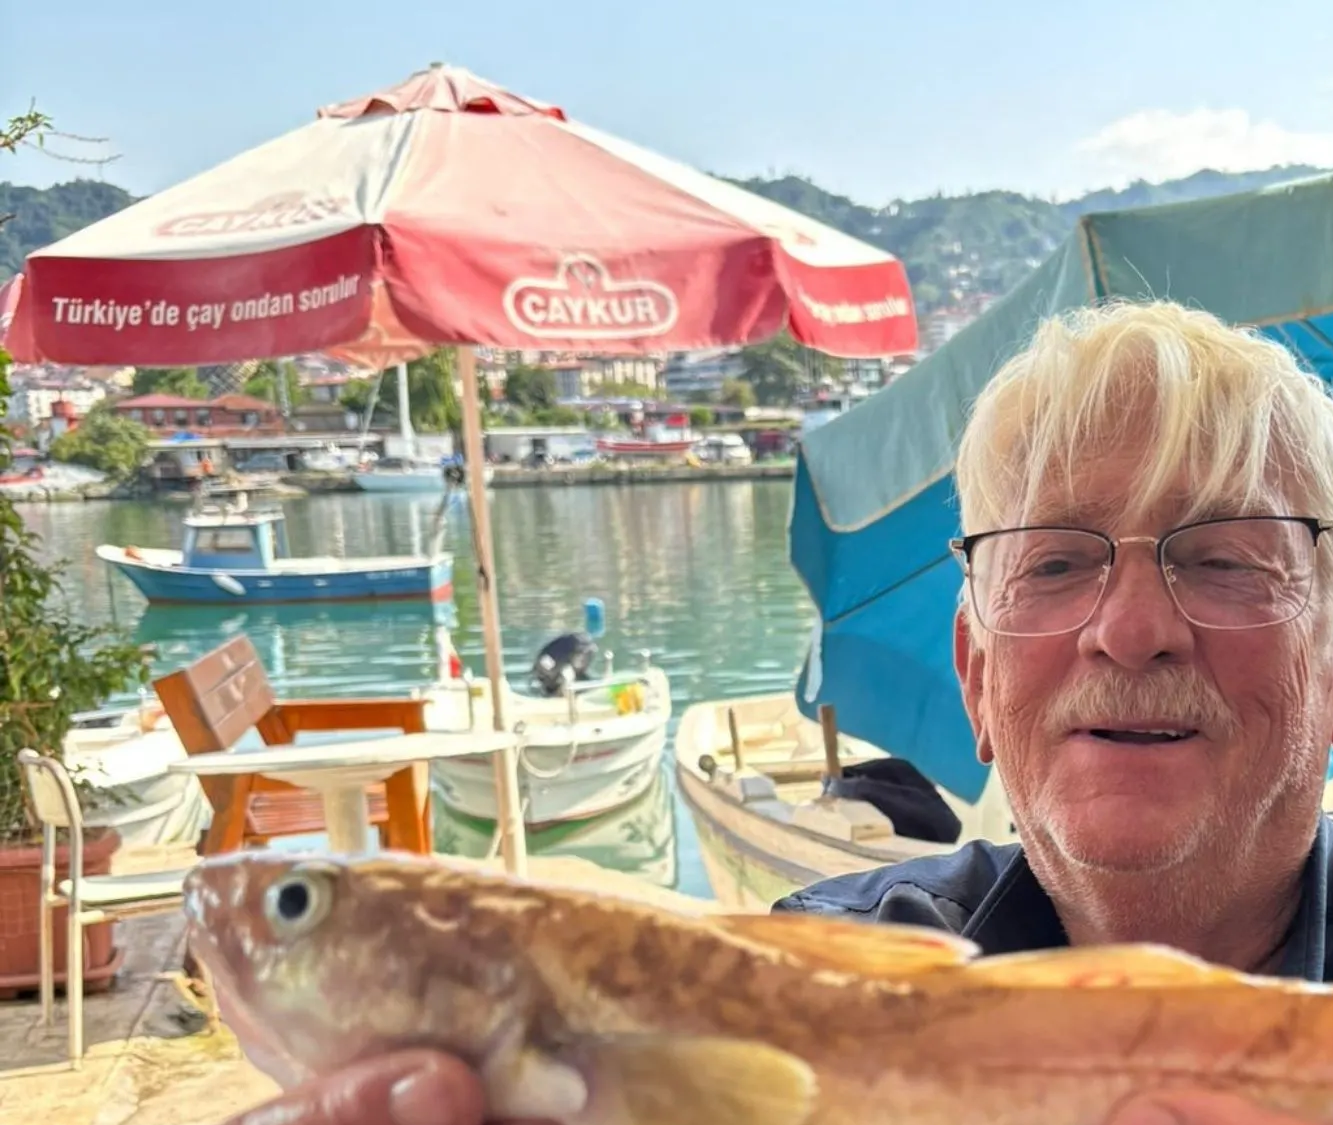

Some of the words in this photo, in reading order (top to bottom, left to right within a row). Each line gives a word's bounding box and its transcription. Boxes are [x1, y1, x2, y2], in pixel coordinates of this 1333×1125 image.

[52, 297, 180, 331] Türkiye'de
[186, 301, 226, 331] çay
[230, 292, 294, 320] ondan
